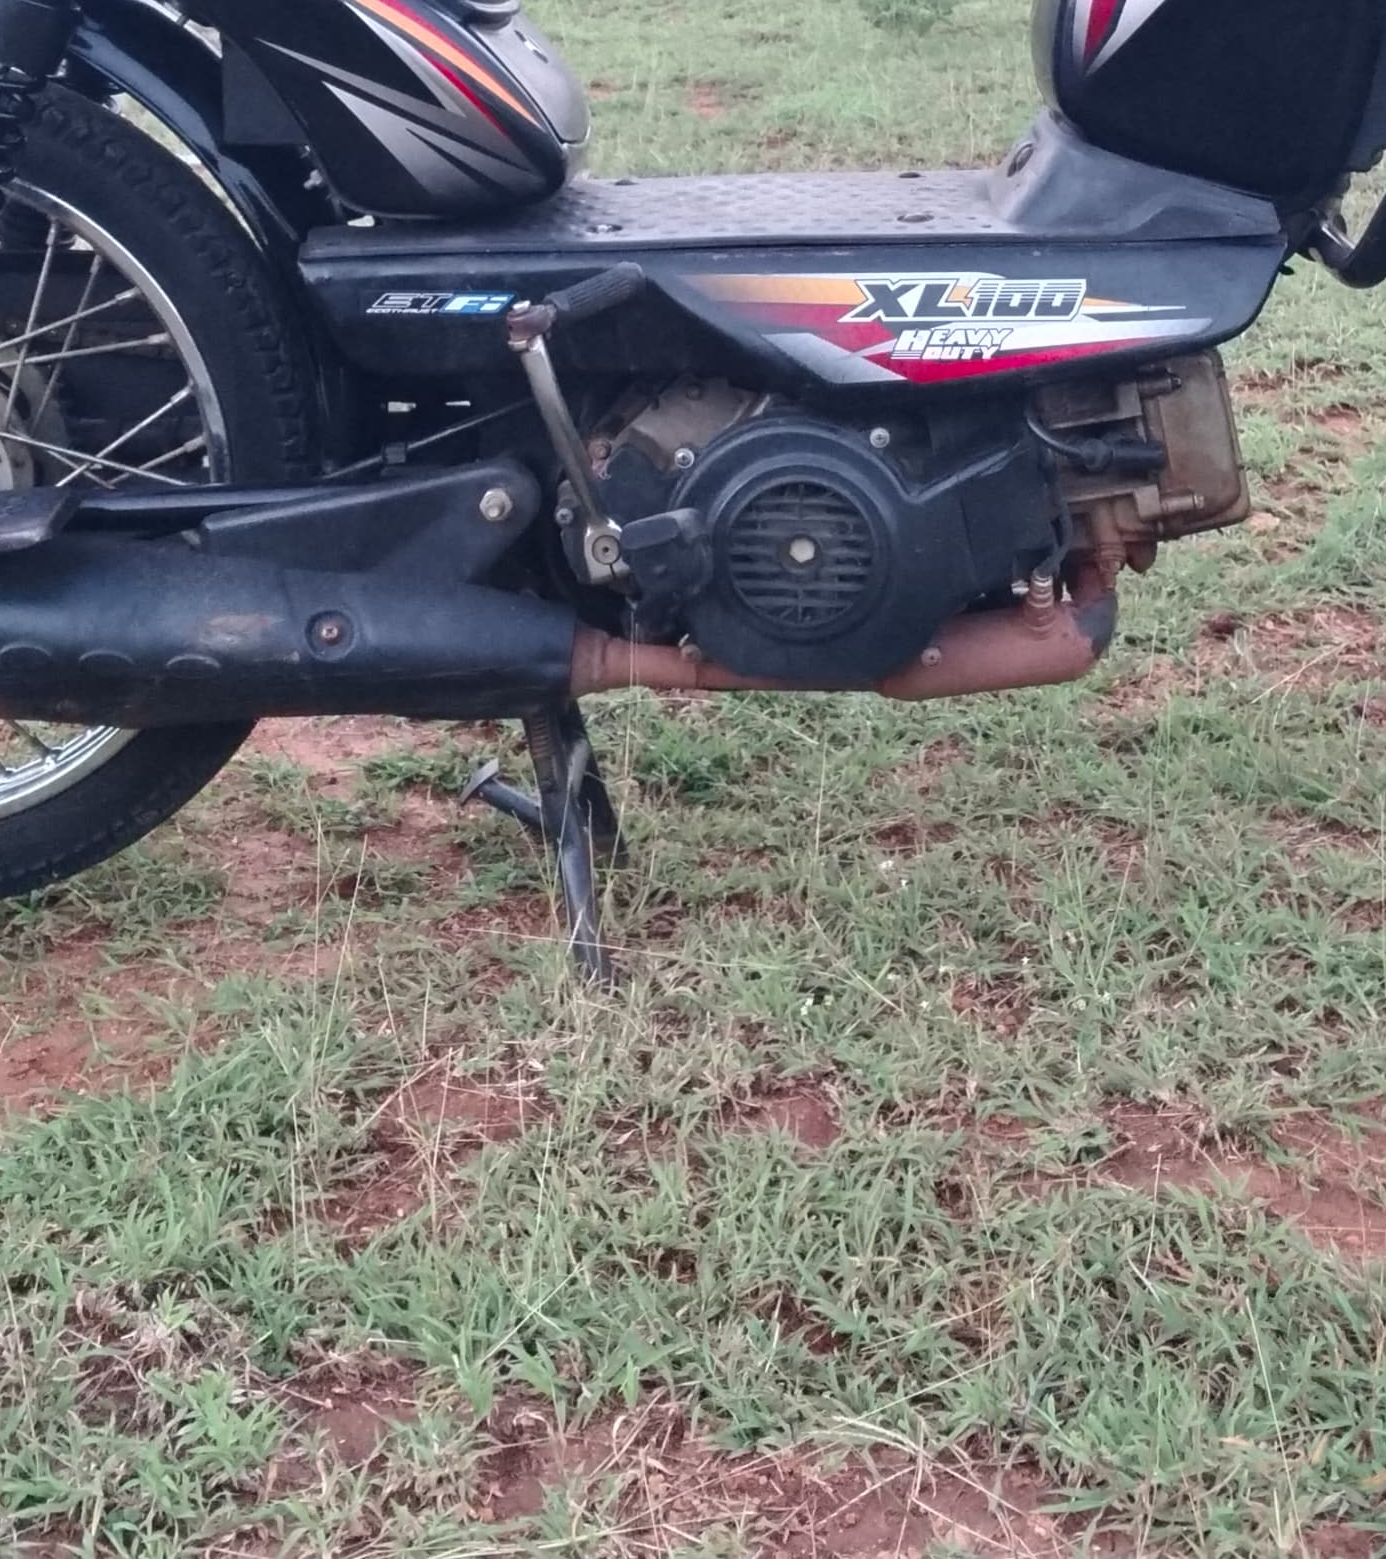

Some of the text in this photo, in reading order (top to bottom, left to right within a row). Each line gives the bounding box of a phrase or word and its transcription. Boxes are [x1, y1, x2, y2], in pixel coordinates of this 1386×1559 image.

[837, 278, 1087, 322] XL100
[890, 328, 1014, 359] HEAVY
[922, 345, 1000, 360] DUTY
